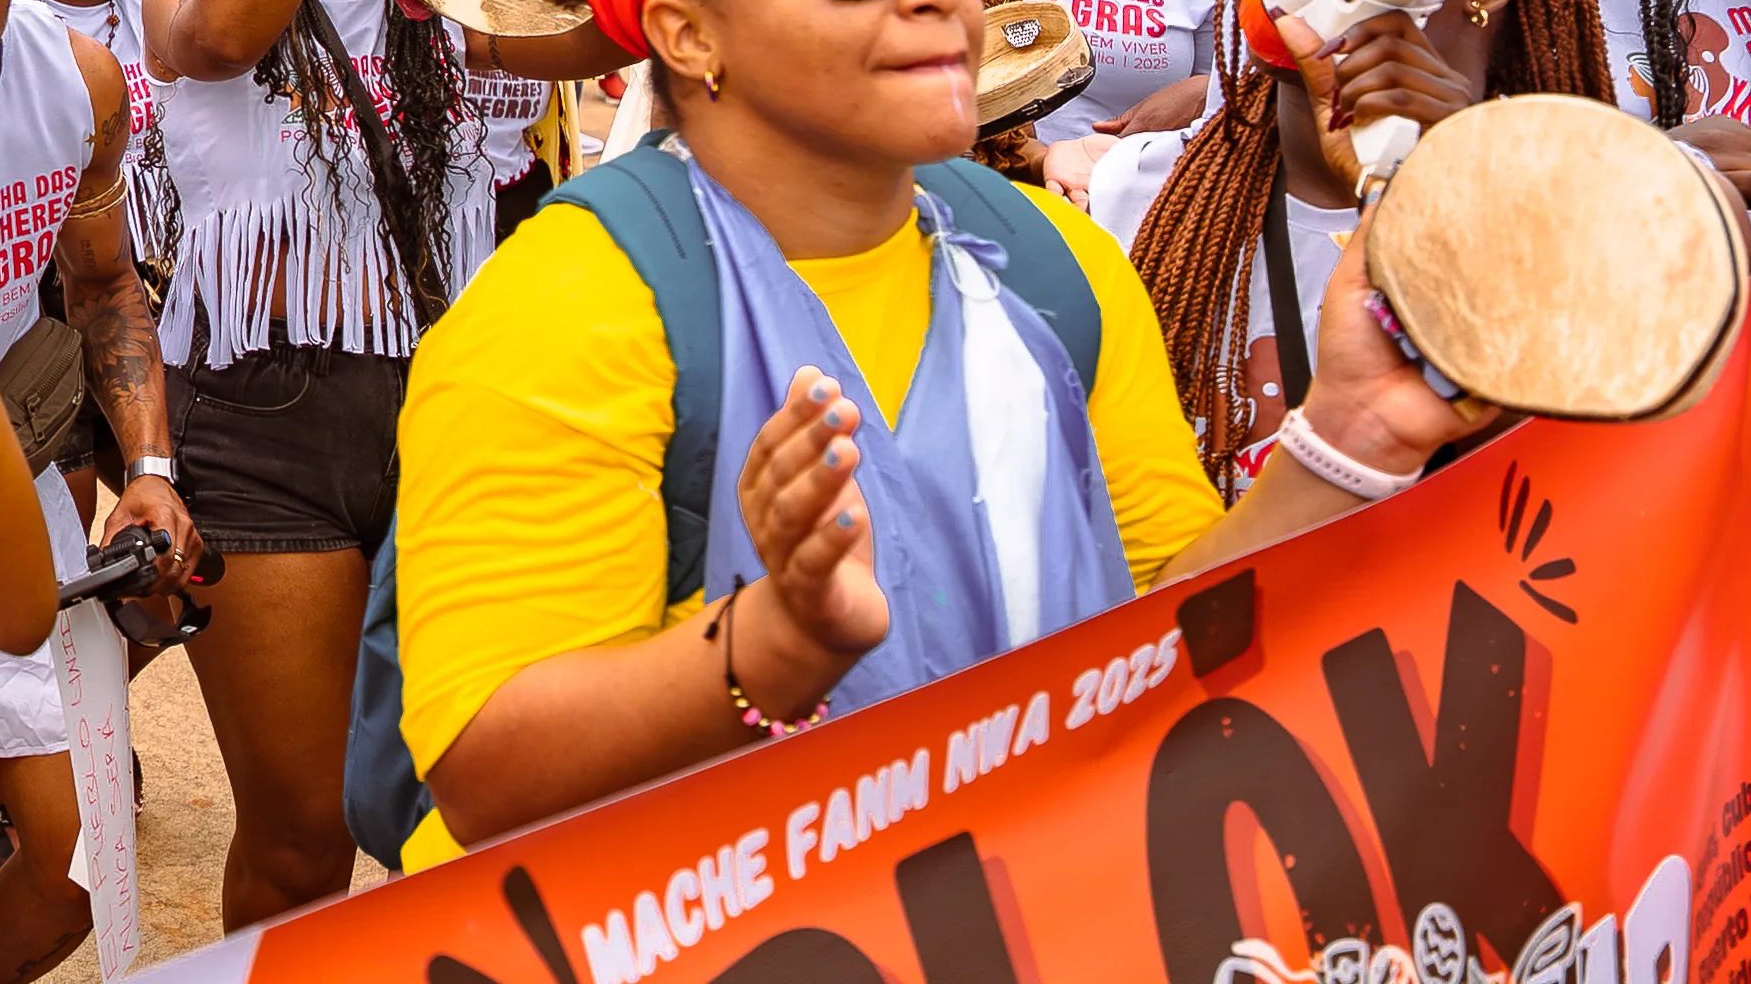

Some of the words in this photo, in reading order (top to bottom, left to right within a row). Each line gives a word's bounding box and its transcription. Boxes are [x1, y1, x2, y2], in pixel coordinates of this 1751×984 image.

[1121, 40, 1168, 56] VIVER
[1133, 56, 1170, 71] 2025
[35, 165, 78, 199] DAS
[1, 282, 32, 307] BEM
[78, 717, 108, 891] PUEBLO
[579, 826, 776, 984] MACHE
[785, 746, 932, 883] FANM
[942, 690, 1052, 797] NWA
[1064, 626, 1184, 733] 2025
[112, 823, 135, 952] NUNCA
[101, 902, 119, 982] EL
